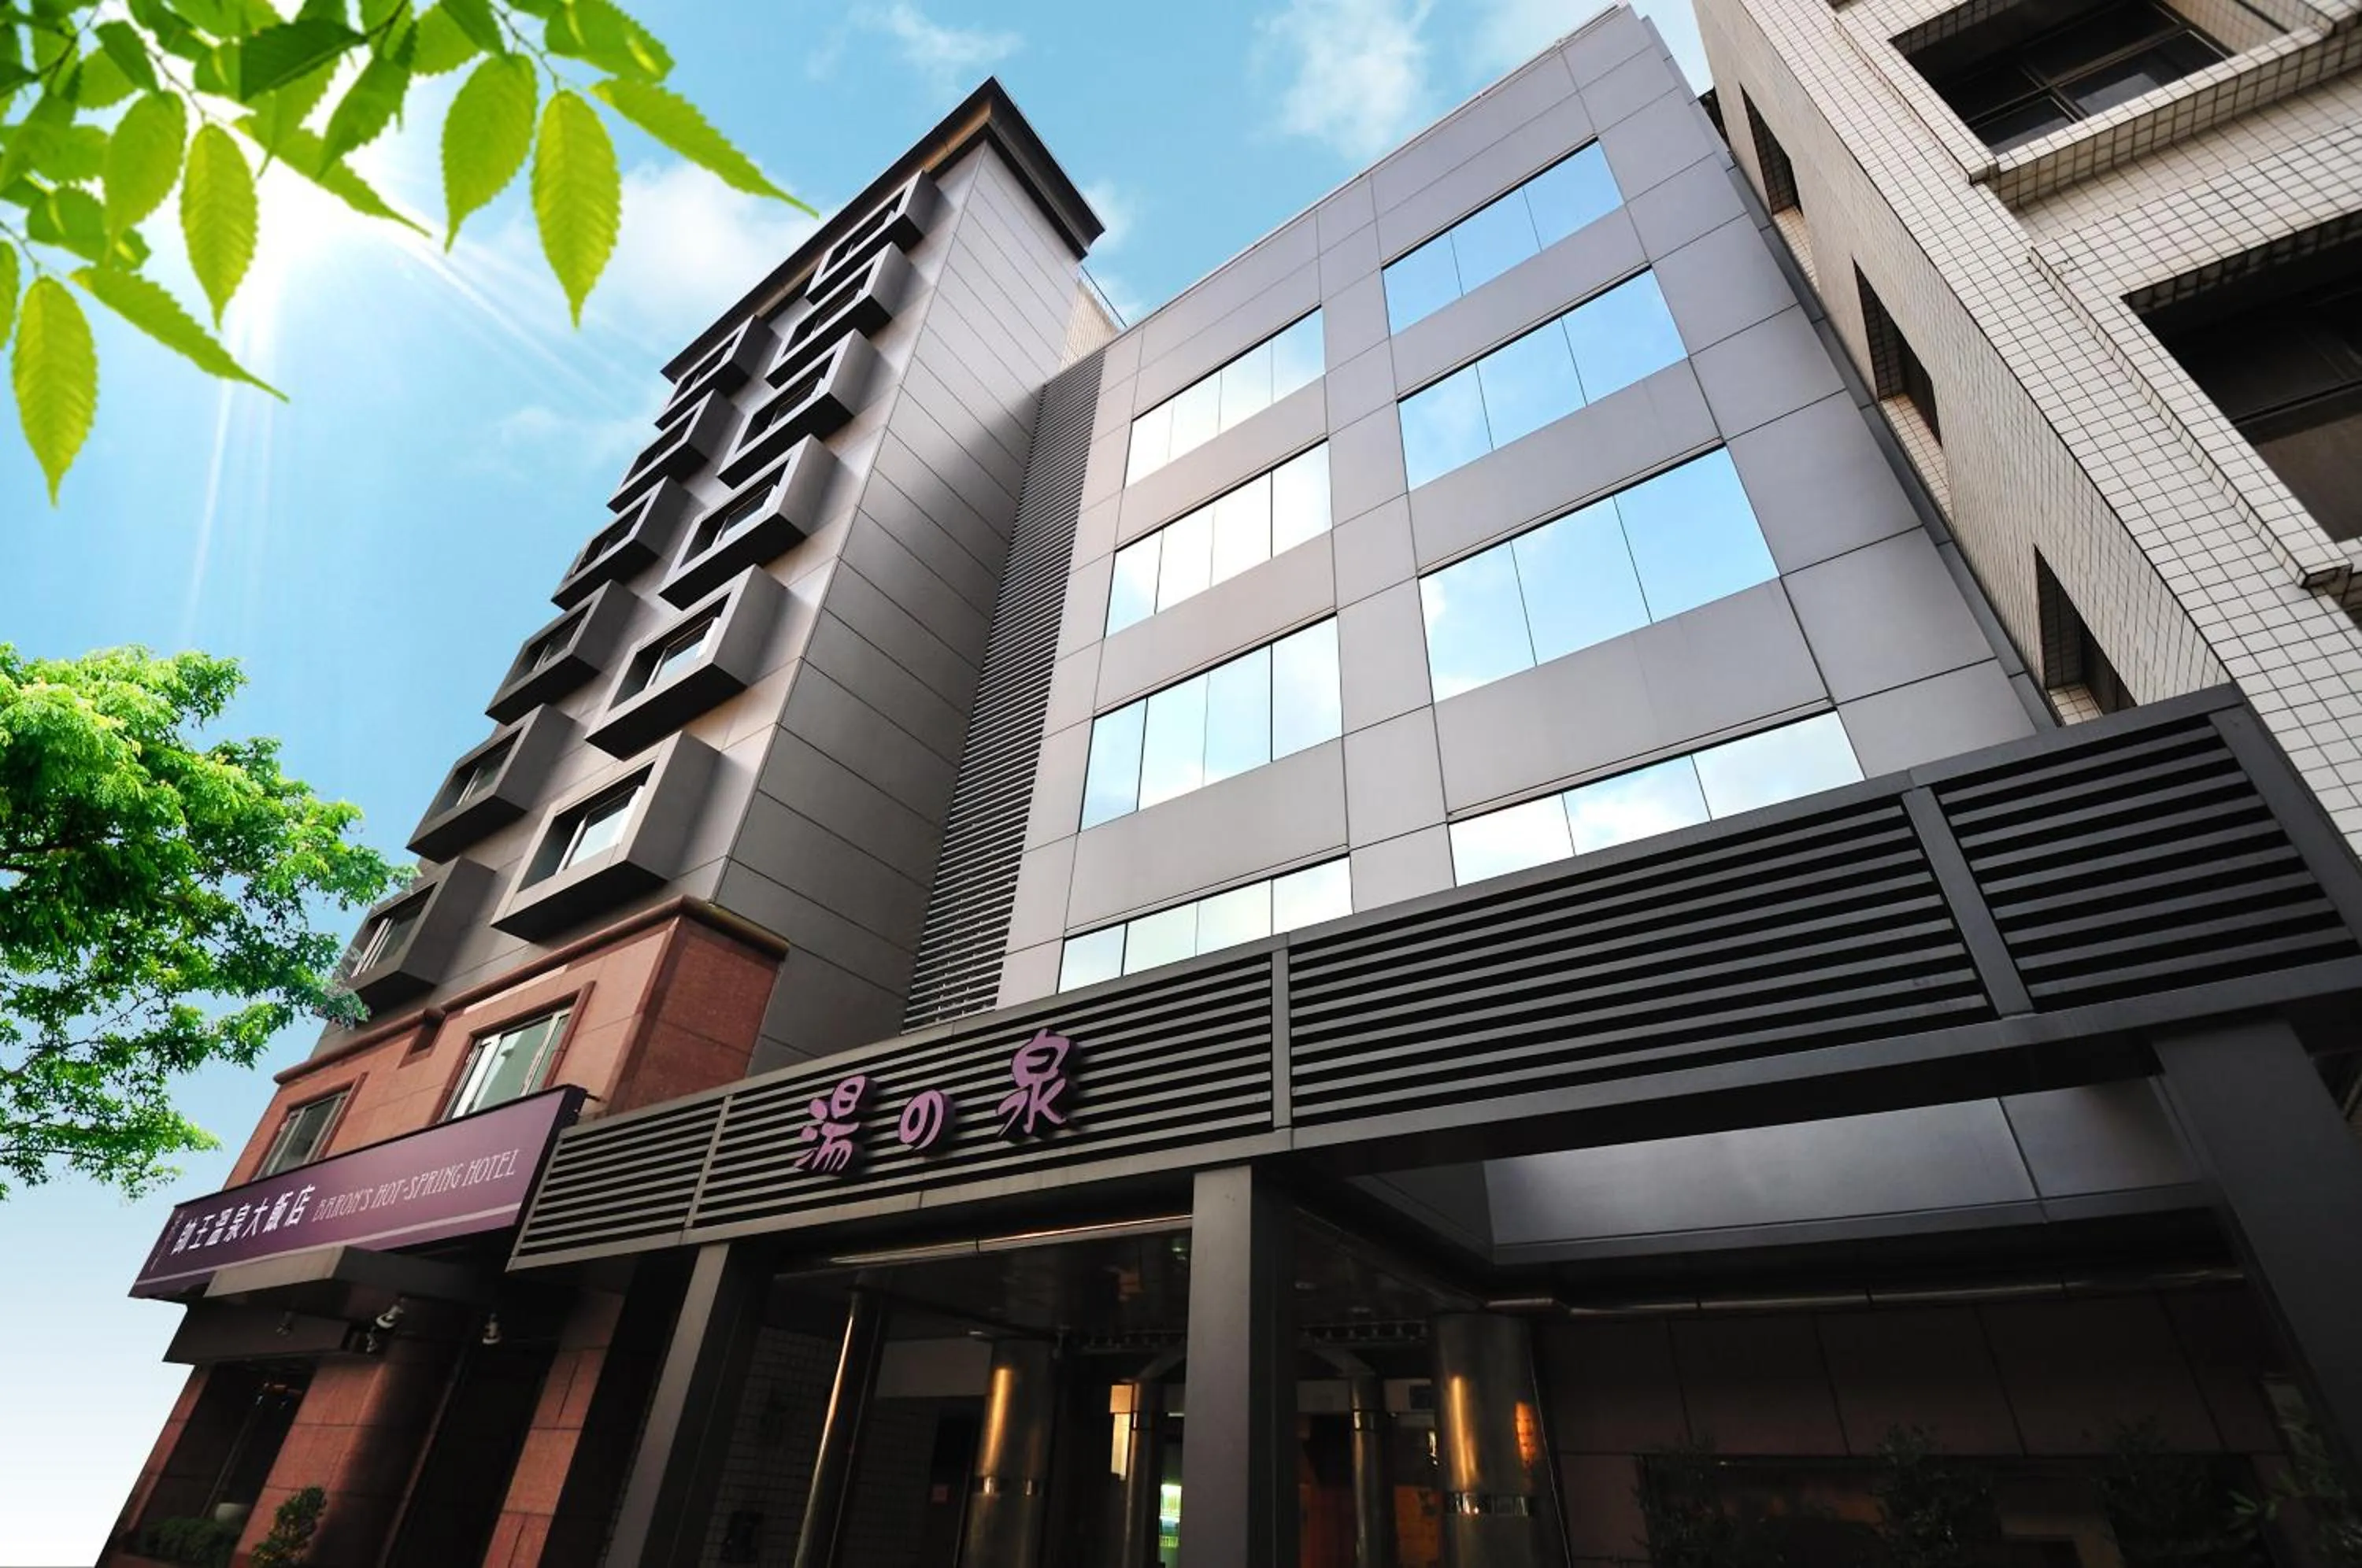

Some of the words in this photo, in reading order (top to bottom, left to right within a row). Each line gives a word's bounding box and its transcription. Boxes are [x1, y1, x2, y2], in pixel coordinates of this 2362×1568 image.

[794, 1028, 1072, 1171] 湯の泉
[313, 1188, 374, 1222] BARON'S
[372, 1163, 464, 1209] HOT-SPRING
[463, 1148, 519, 1187] HOTEL
